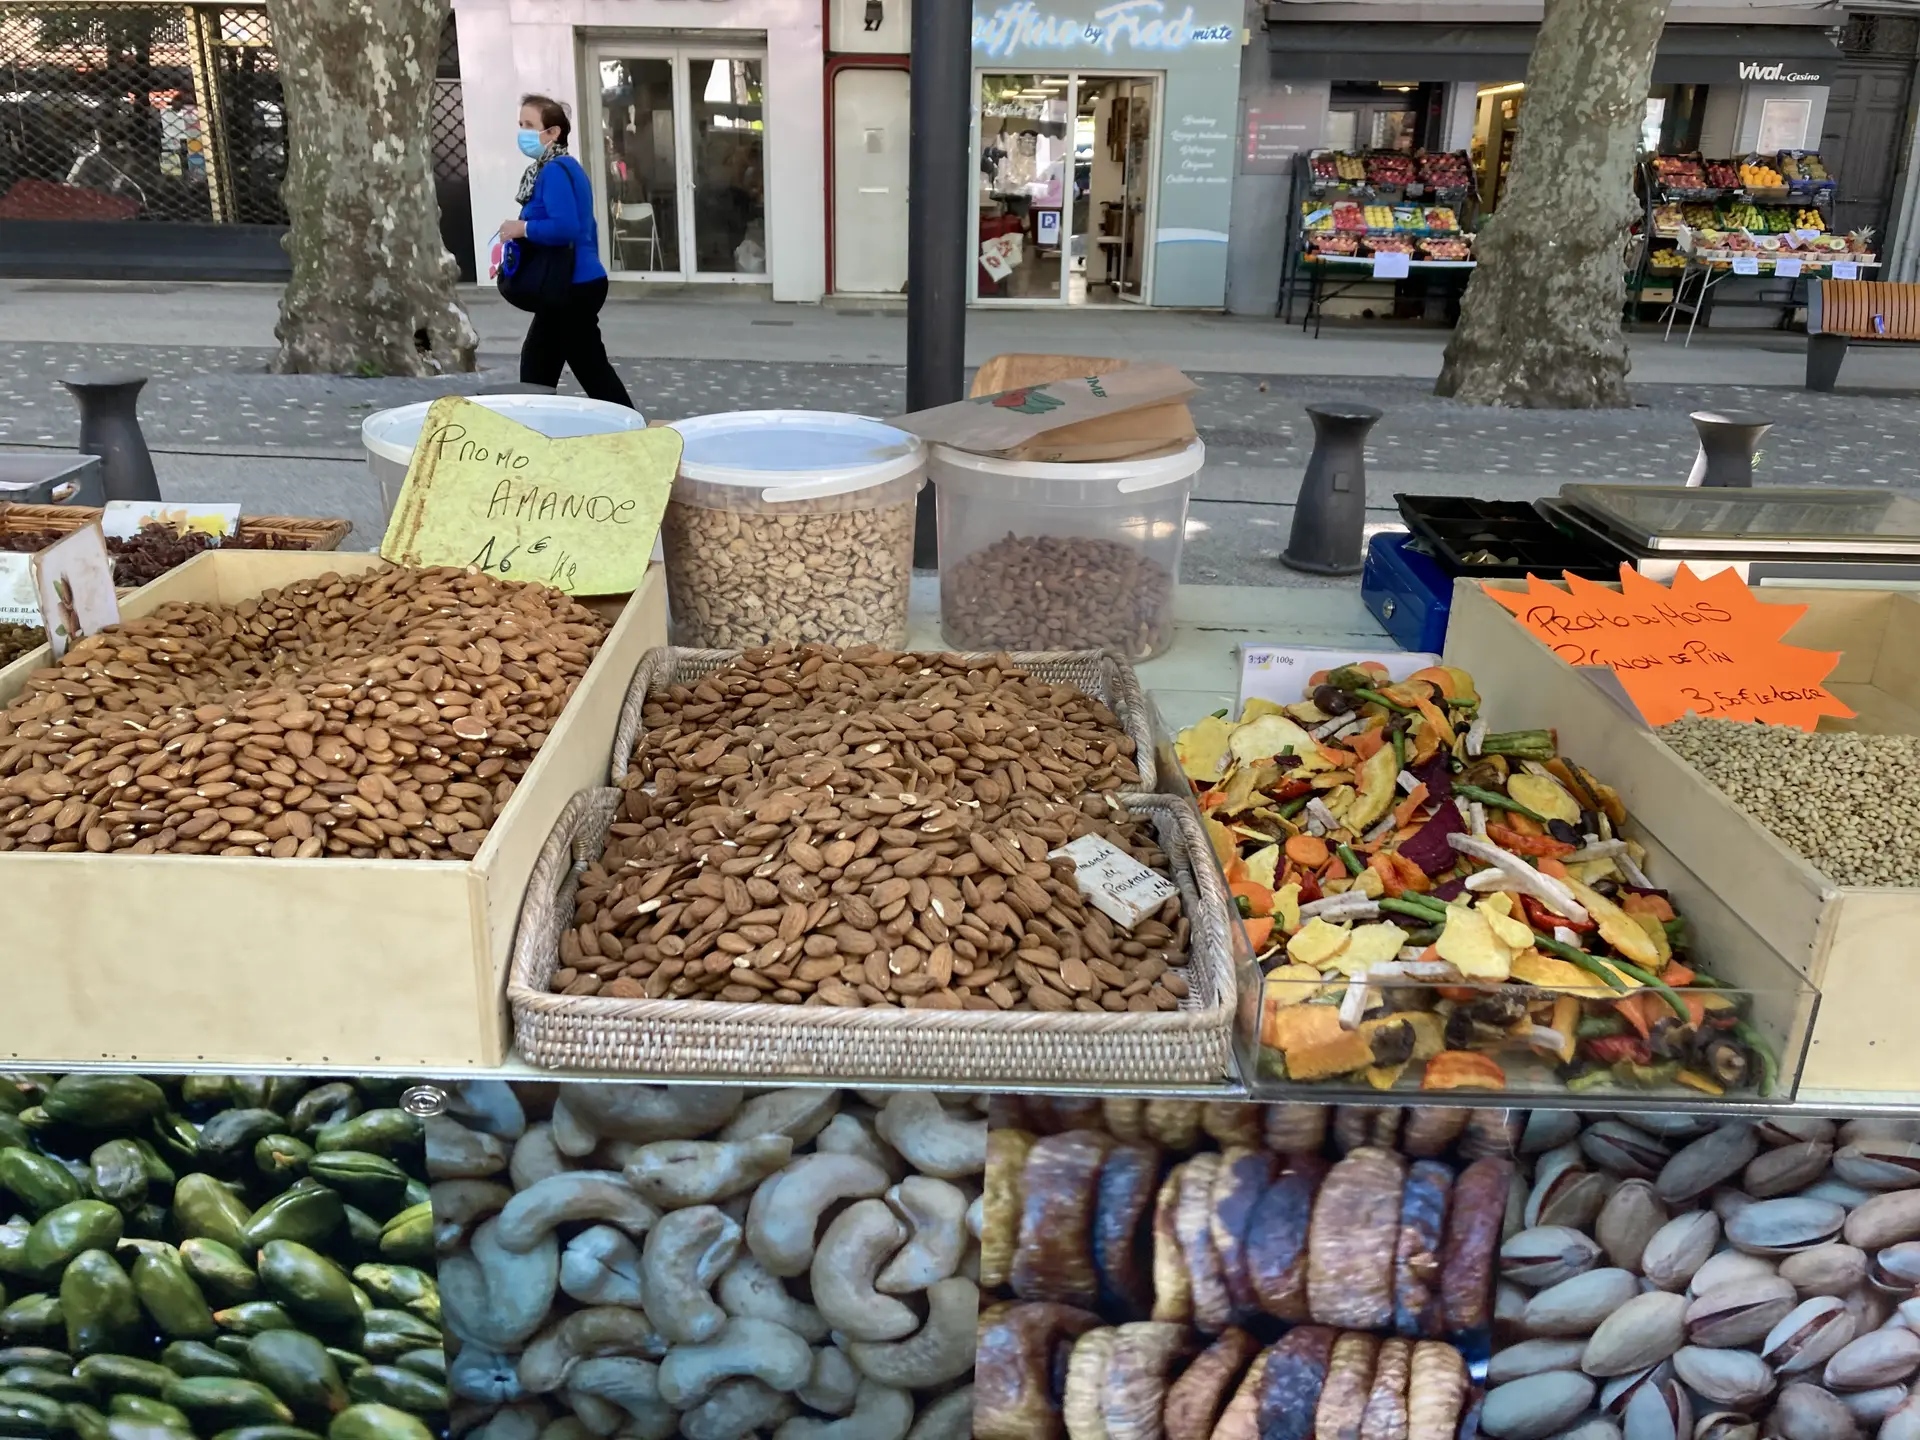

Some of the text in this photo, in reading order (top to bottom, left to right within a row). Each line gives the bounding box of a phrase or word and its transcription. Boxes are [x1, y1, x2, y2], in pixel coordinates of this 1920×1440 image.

[1083, 22, 1103, 43] by
[1094, 0, 1193, 51] Fred
[1191, 24, 1232, 40] mixte
[1739, 62, 1783, 81] Vival
[1786, 73, 1820, 83] Casino
[1276, 656, 1295, 666] 100g
